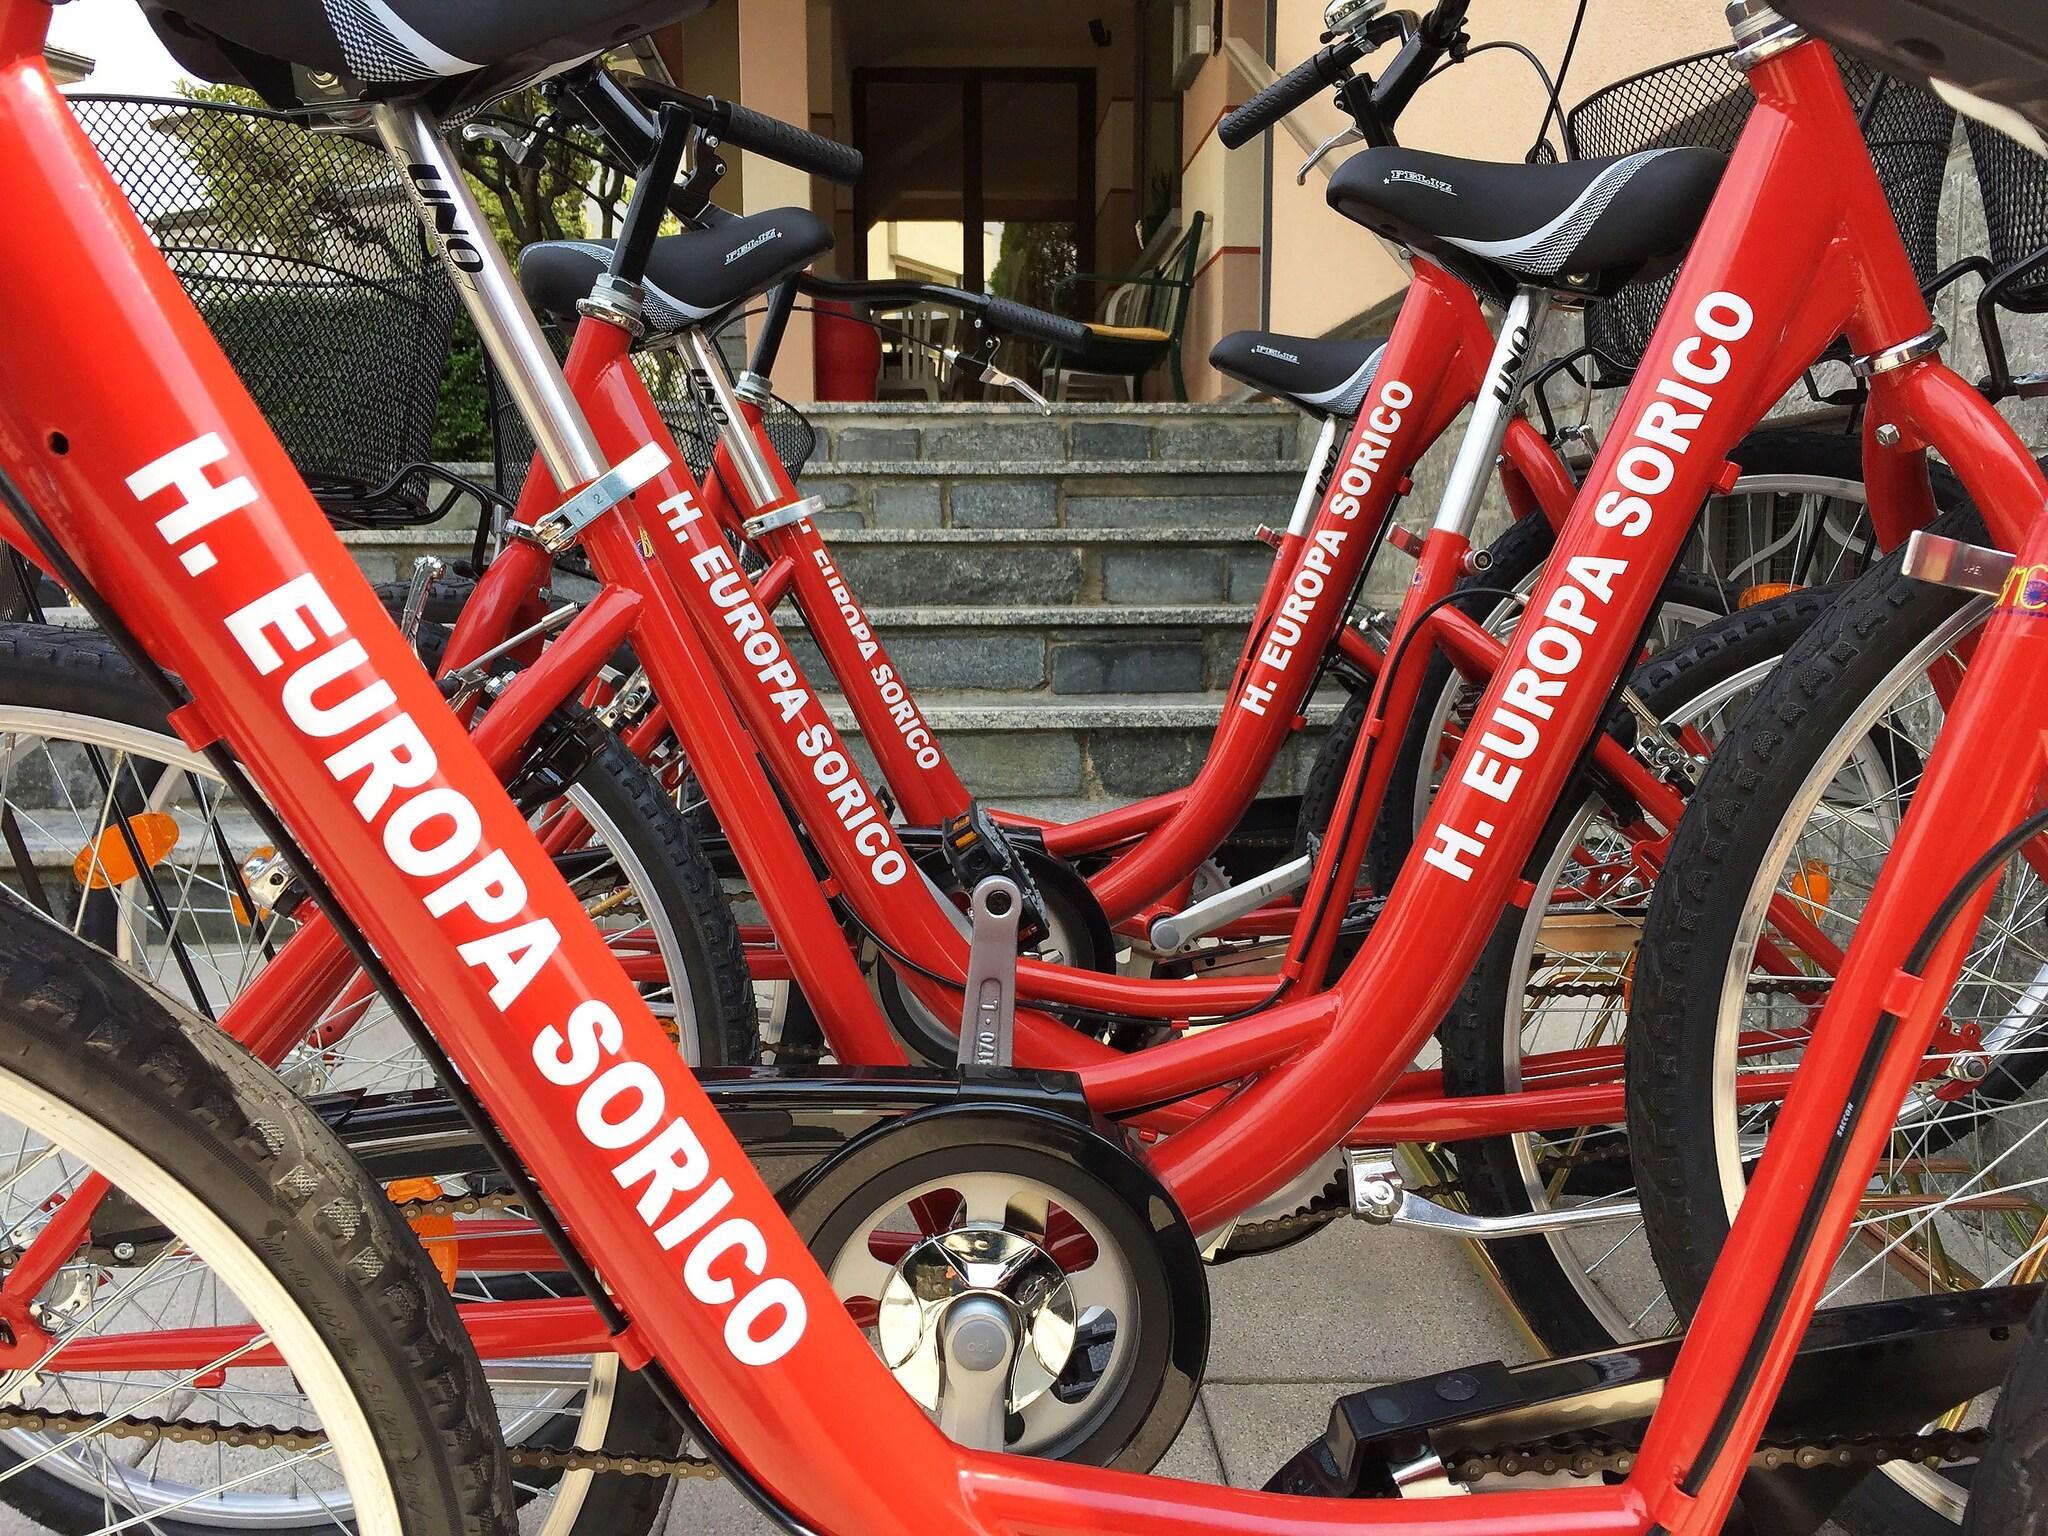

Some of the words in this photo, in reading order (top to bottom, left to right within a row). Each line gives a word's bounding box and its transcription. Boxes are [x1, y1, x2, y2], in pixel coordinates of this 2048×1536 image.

[407, 163, 484, 273] UNO
[690, 368, 729, 425] UNO
[1492, 326, 1530, 405] UNO
[592, 493, 605, 505] 2
[1240, 680, 1278, 716] H.
[1260, 530, 1348, 671] EUROPA
[1330, 380, 1413, 520] SORICO
[1424, 820, 1493, 882] H.
[1462, 557, 1628, 803] EUROPA
[1595, 291, 1754, 537] SORICO
[656, 490, 704, 544] H.
[690, 545, 811, 724] EUROPA
[796, 723, 907, 885] SORICO
[870, 664, 940, 770] SORICO
[125, 432, 260, 576] H.
[224, 568, 561, 1012] EUROPA
[533, 1000, 808, 1366] SORICO
